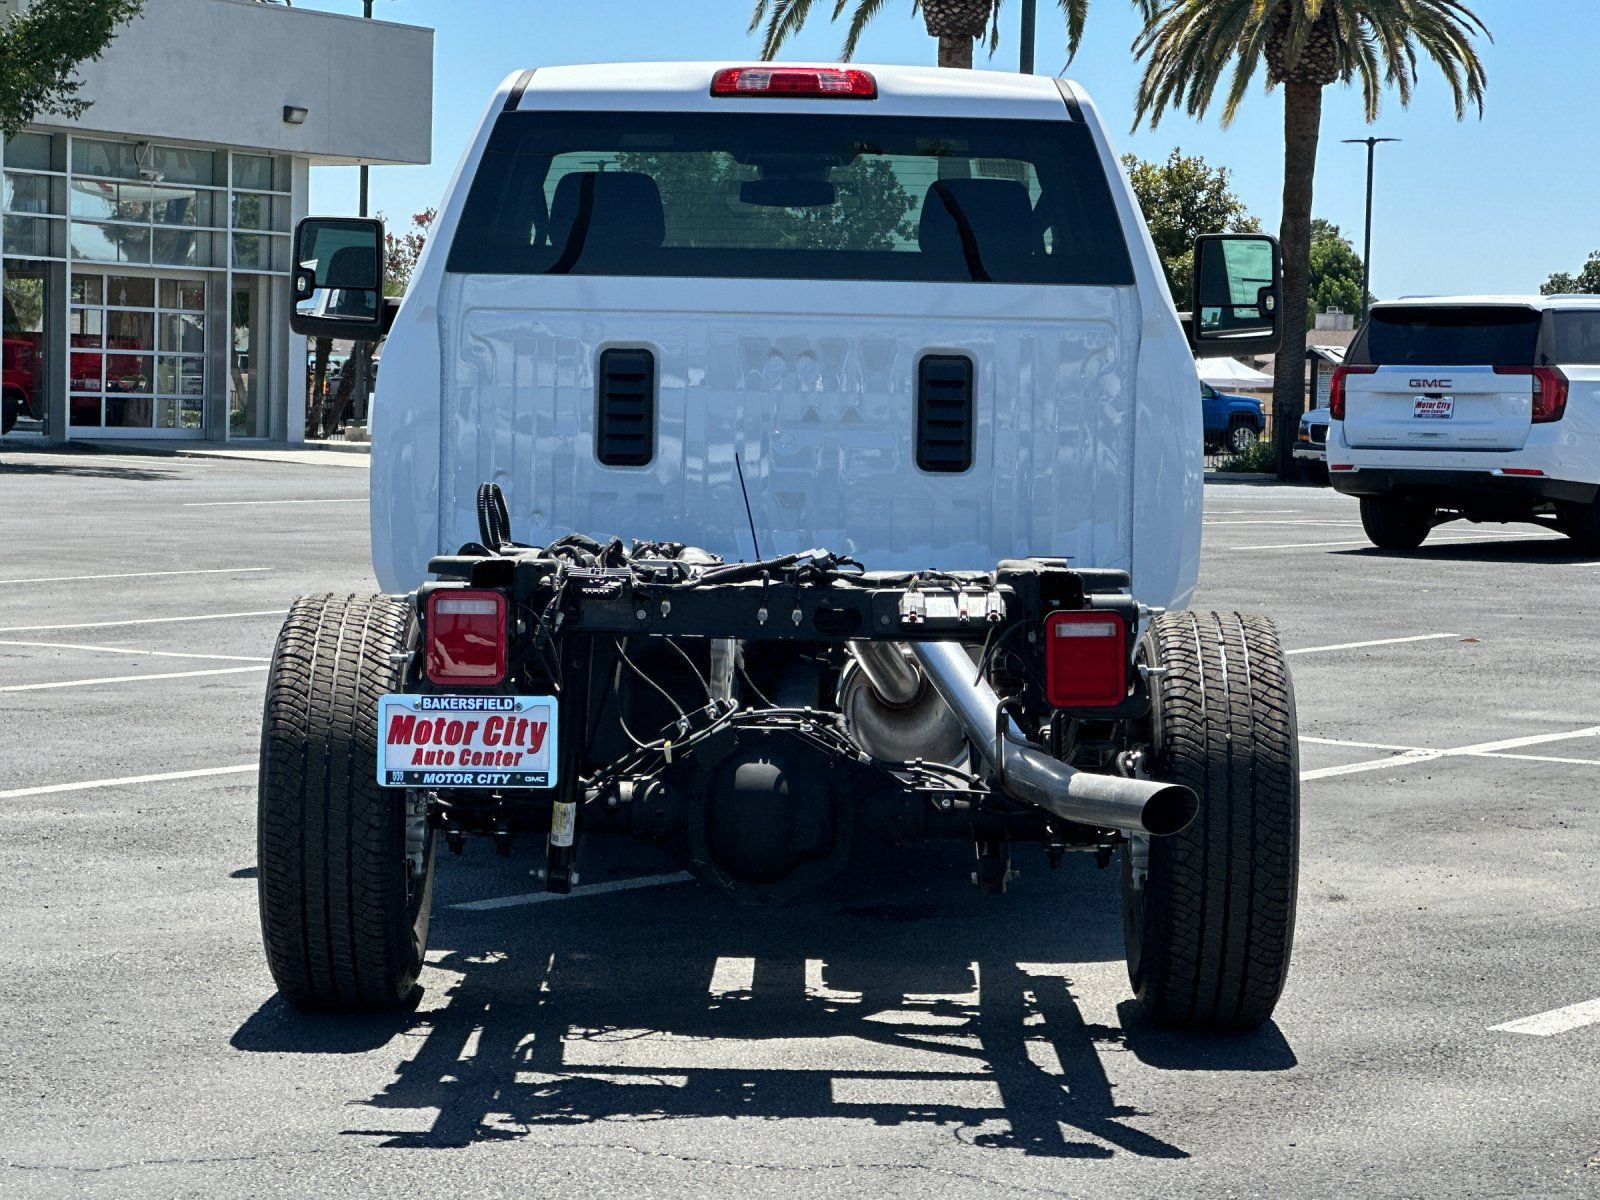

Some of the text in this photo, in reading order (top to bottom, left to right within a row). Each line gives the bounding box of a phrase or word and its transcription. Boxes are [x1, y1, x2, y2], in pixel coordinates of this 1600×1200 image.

[1409, 379, 1452, 388] GMC
[1415, 401, 1451, 411] Motor City
[422, 697, 514, 711] BAKERSFIELD
[387, 715, 548, 754] Motor City
[411, 748, 523, 767] Auto Center
[423, 773, 475, 784] MOTOR
[477, 773, 511, 784] CITY
